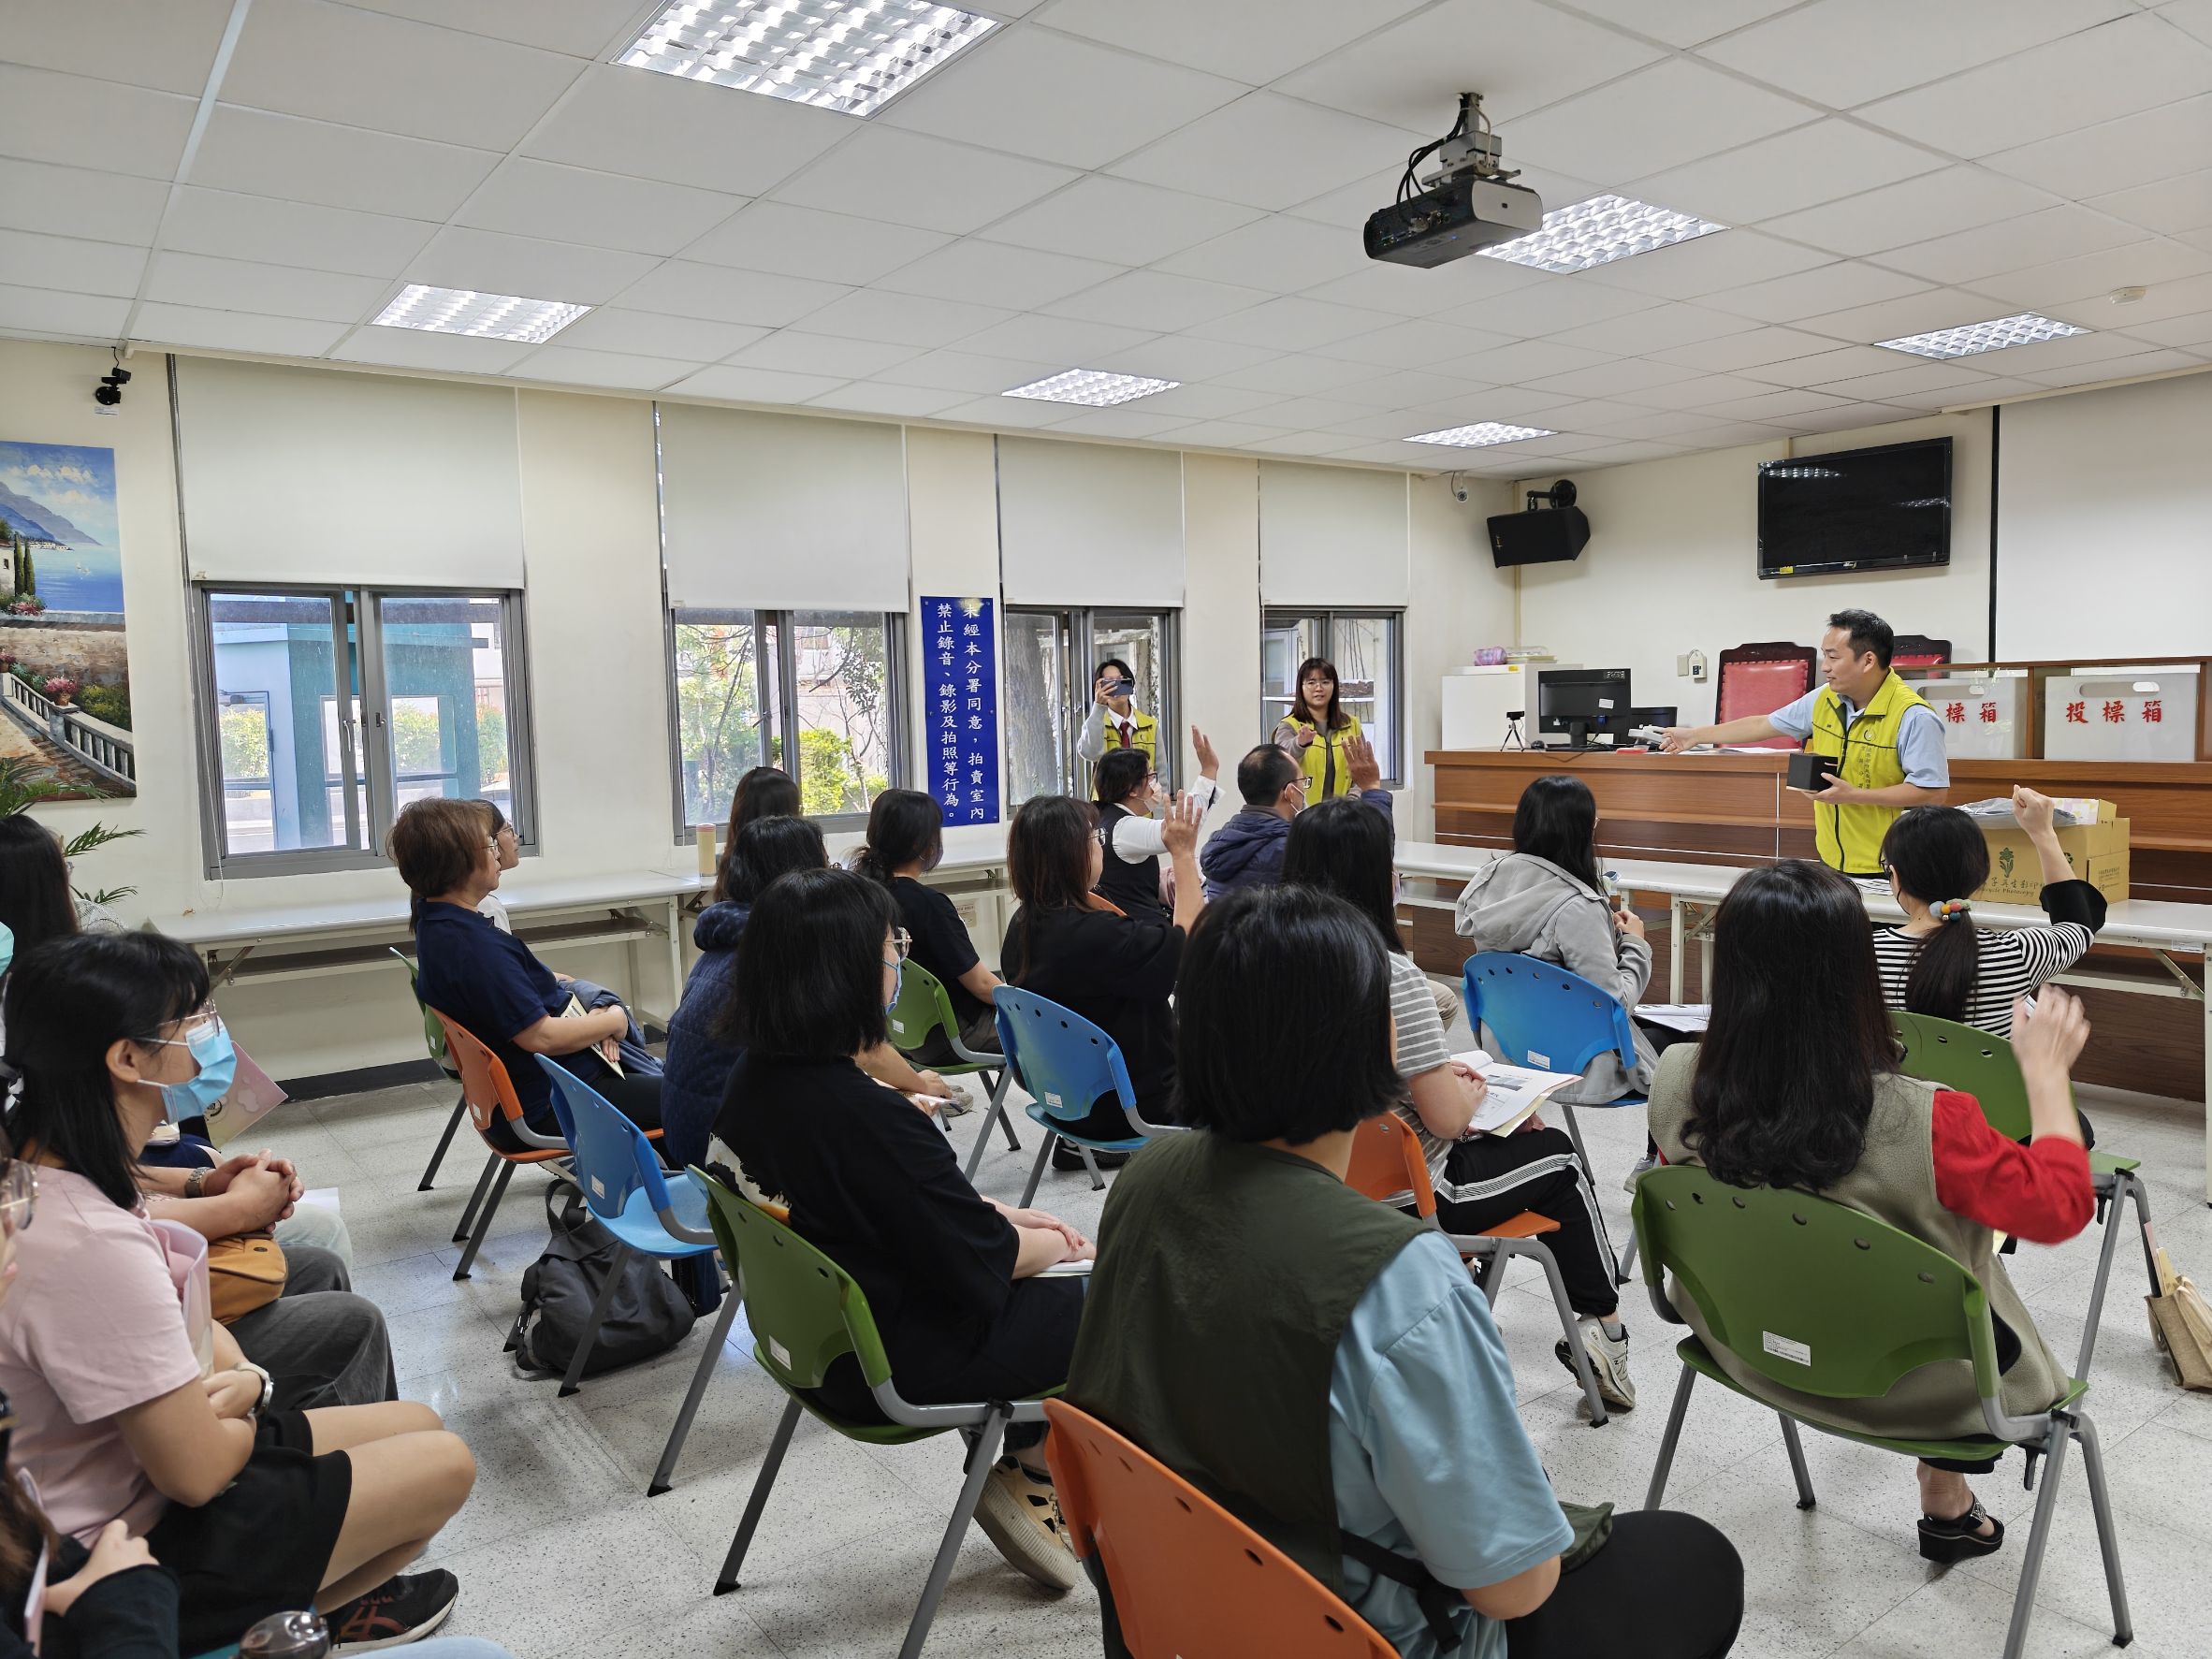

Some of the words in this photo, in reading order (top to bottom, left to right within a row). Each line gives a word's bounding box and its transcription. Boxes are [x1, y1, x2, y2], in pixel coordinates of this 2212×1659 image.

[937, 603, 960, 819] 禁止錄音、錄影及拍照等行為。
[963, 604, 984, 820] 未經本分署同意，拍賣室內
[1945, 702, 1998, 723] 標箱
[2065, 700, 2162, 723] 投標箱
